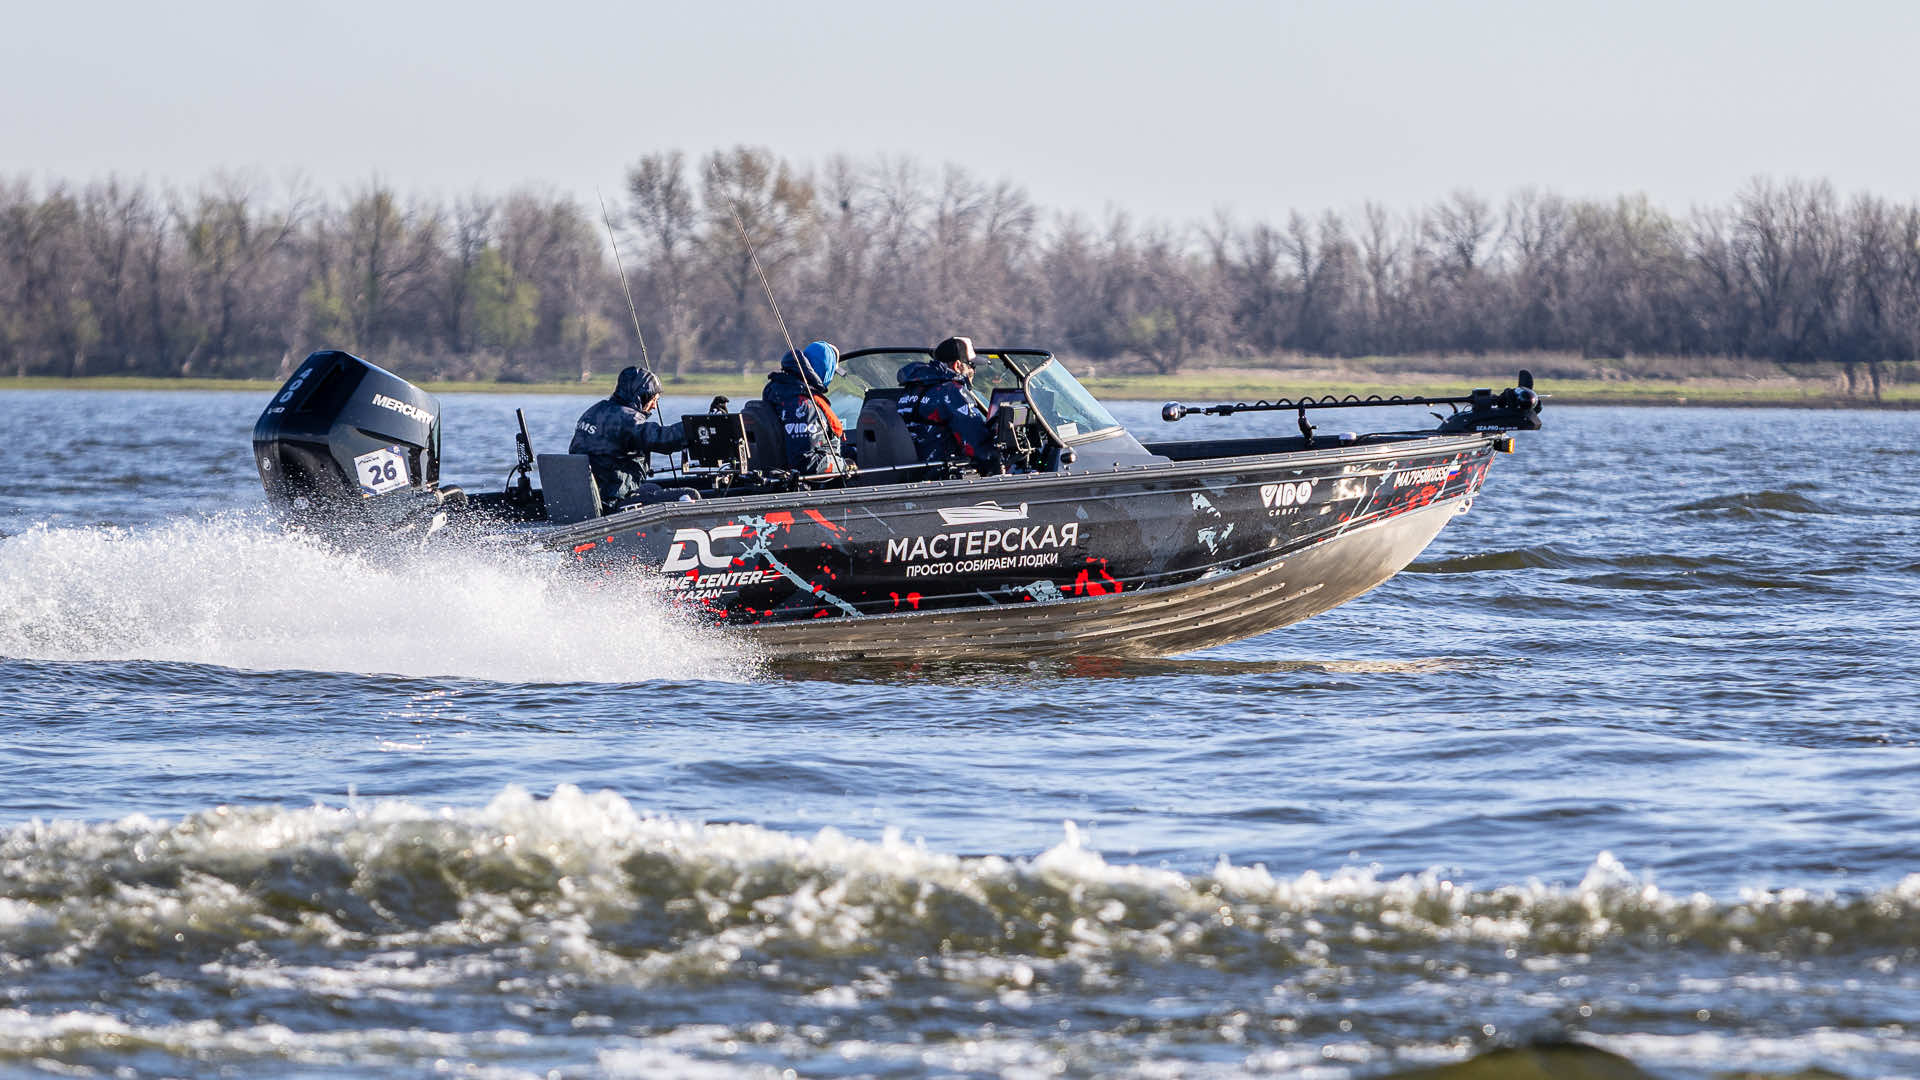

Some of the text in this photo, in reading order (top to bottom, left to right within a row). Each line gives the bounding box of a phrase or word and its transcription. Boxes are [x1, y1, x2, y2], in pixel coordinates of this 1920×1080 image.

[371, 392, 435, 425] MERCURY
[368, 459, 398, 487] 26
[661, 524, 745, 573] DC
[884, 522, 1079, 563] МАСТЕРСКАЯ
[906, 552, 1059, 577] ПРОСТО СОБИРАЕМ ЛОДКИ
[695, 570, 765, 588] CENTER
[676, 588, 723, 601] KAZAN
